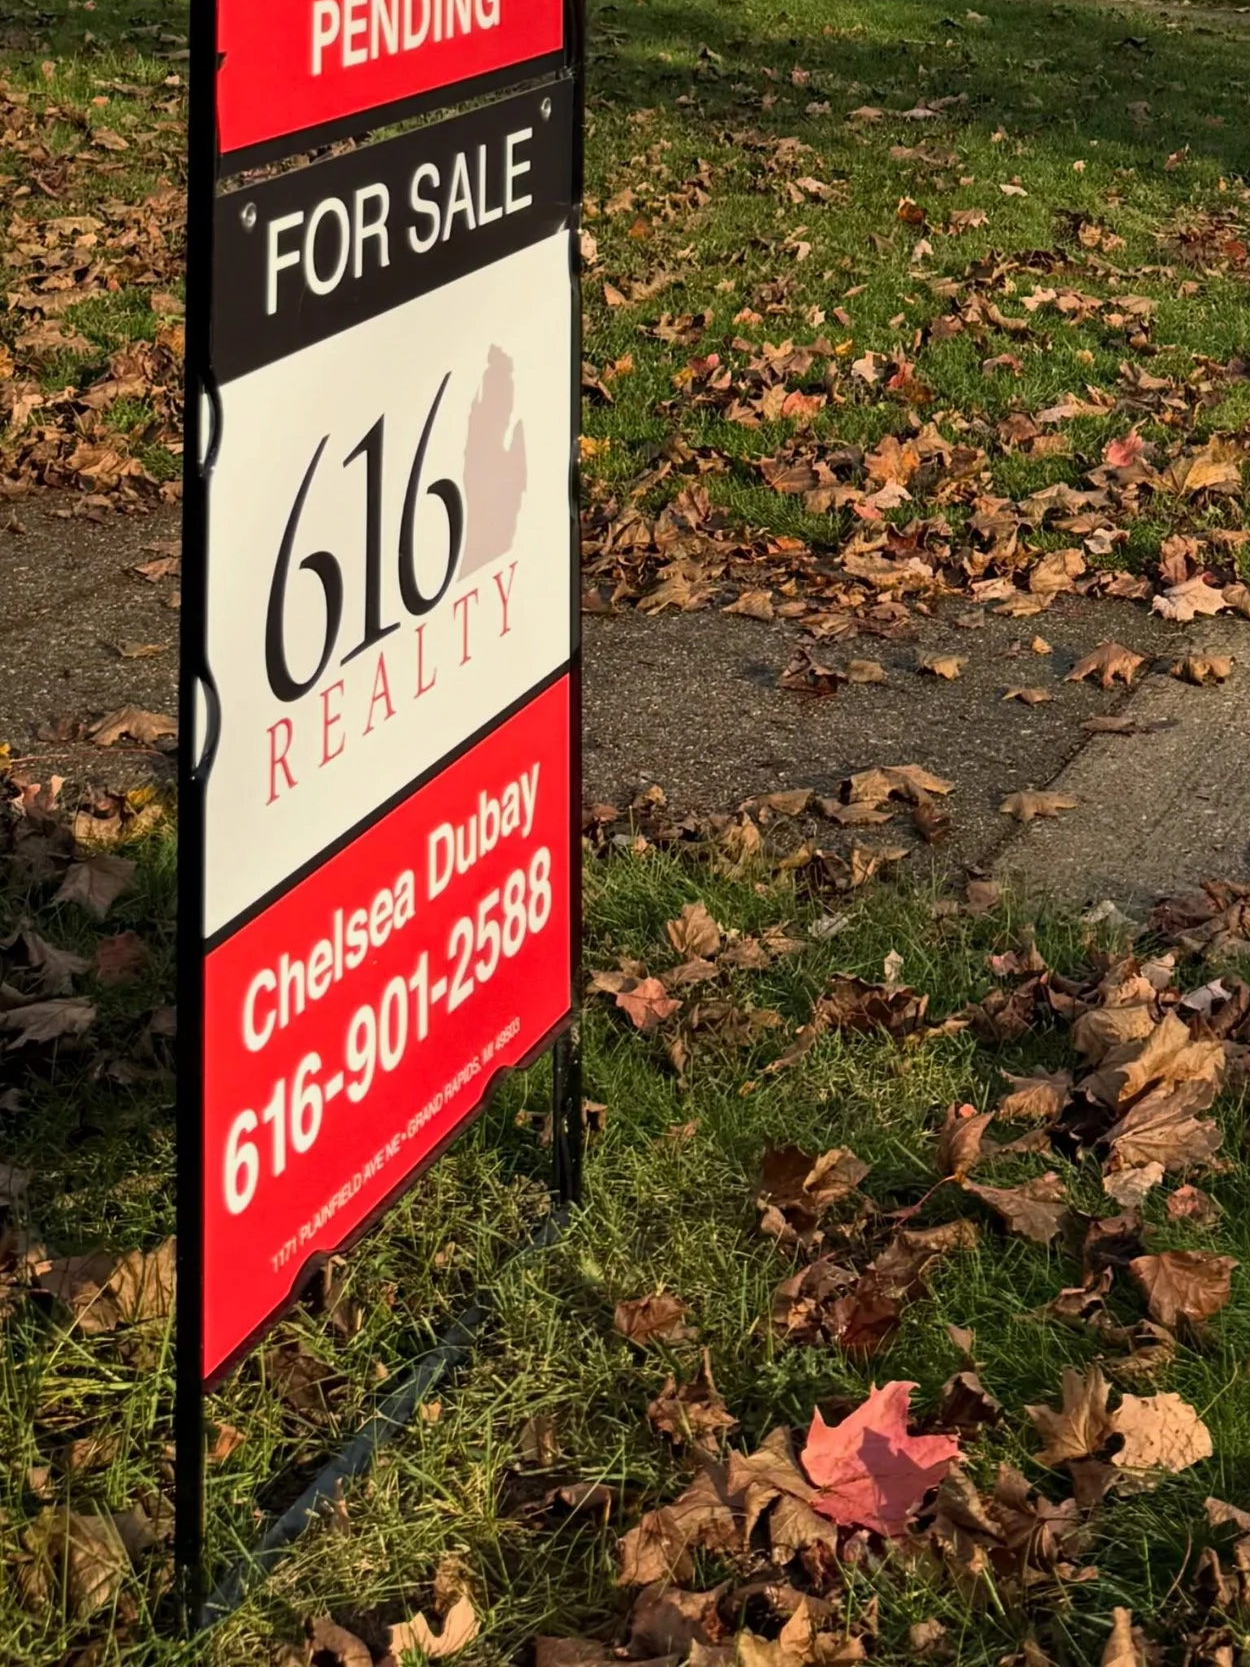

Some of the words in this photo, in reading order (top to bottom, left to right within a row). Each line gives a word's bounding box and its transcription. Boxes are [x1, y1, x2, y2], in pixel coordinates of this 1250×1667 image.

[265, 182, 391, 316] FOR
[408, 127, 534, 255] SALE
[264, 371, 465, 704] 616
[265, 561, 519, 807] REALTY
[222, 845, 554, 1217] 616-901-2588
[242, 869, 416, 1054] Chelsea
[427, 761, 541, 904] Dubay
[299, 1172, 363, 1246] PLAINFIELD
[362, 1150, 385, 1183] AVE
[384, 1133, 401, 1161] NE
[407, 1092, 444, 1139] GRAND
